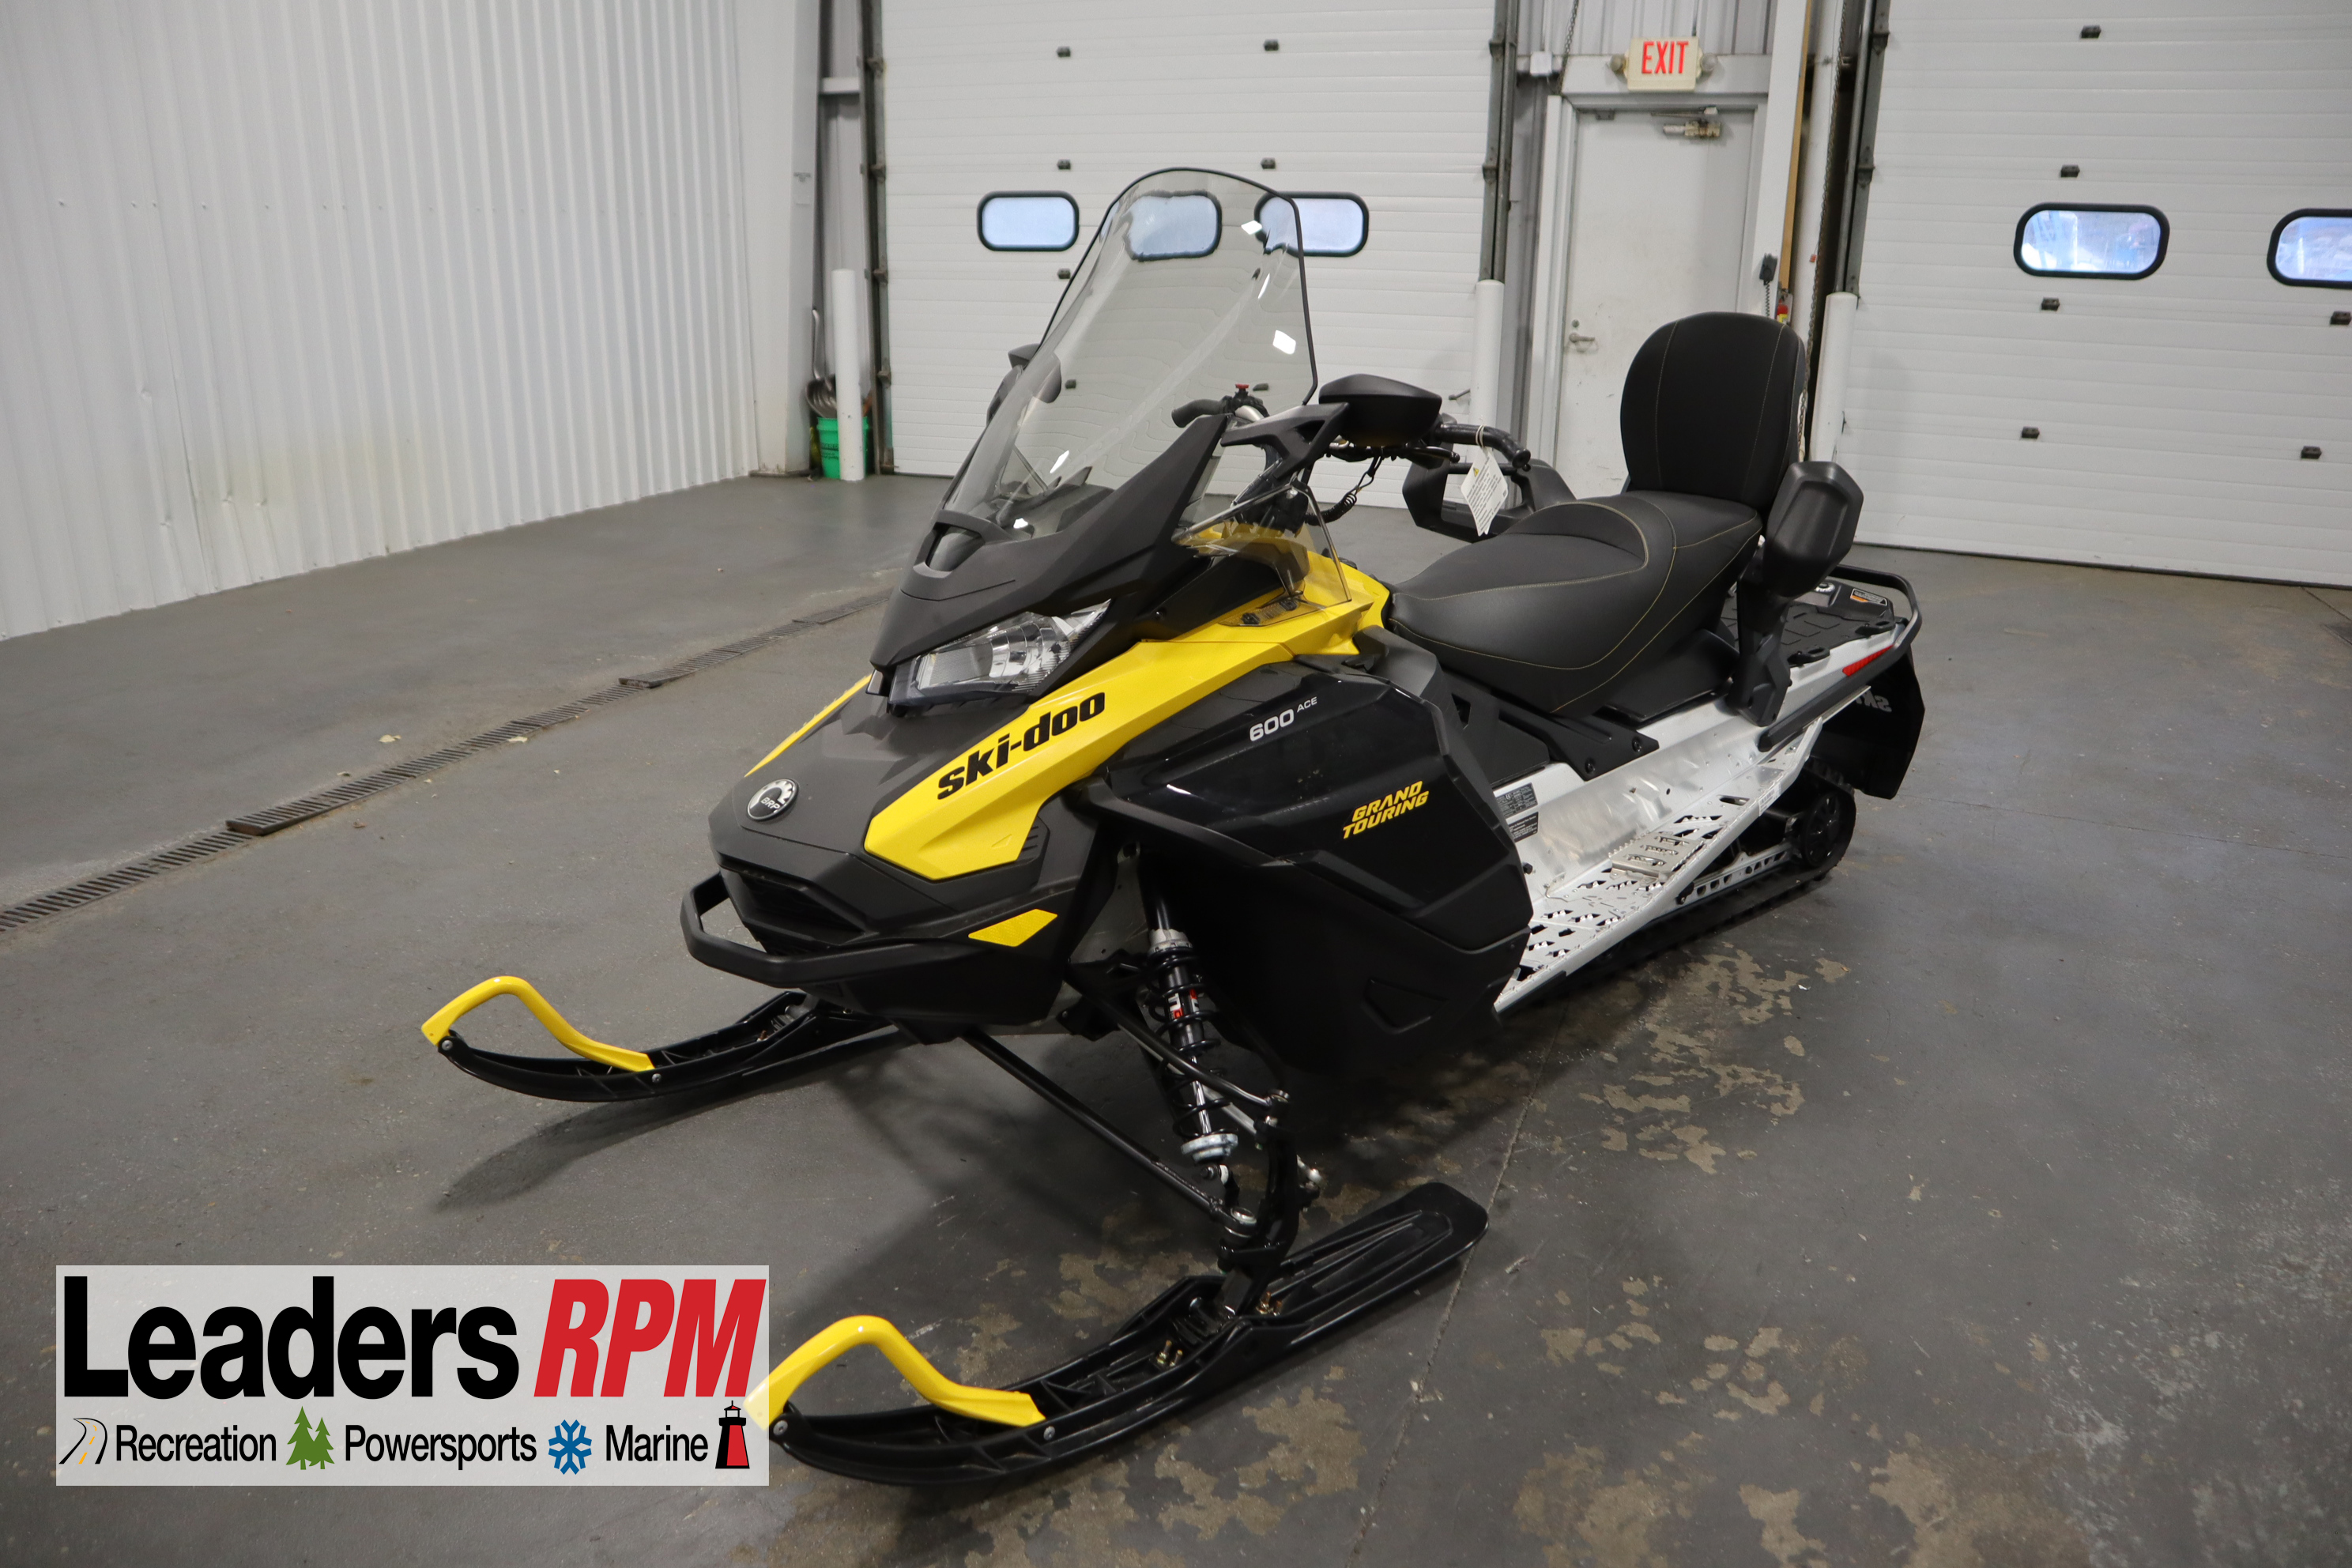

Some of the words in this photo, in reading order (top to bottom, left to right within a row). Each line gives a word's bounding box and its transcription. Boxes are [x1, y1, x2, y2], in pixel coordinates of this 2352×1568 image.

[1641, 40, 1689, 74] EXIT
[1249, 708, 1295, 742] 600
[1296, 696, 1318, 713] ACE
[760, 797, 781, 809] BRP
[1342, 790, 1430, 839] TOURING
[1351, 780, 1423, 823] GRAND
